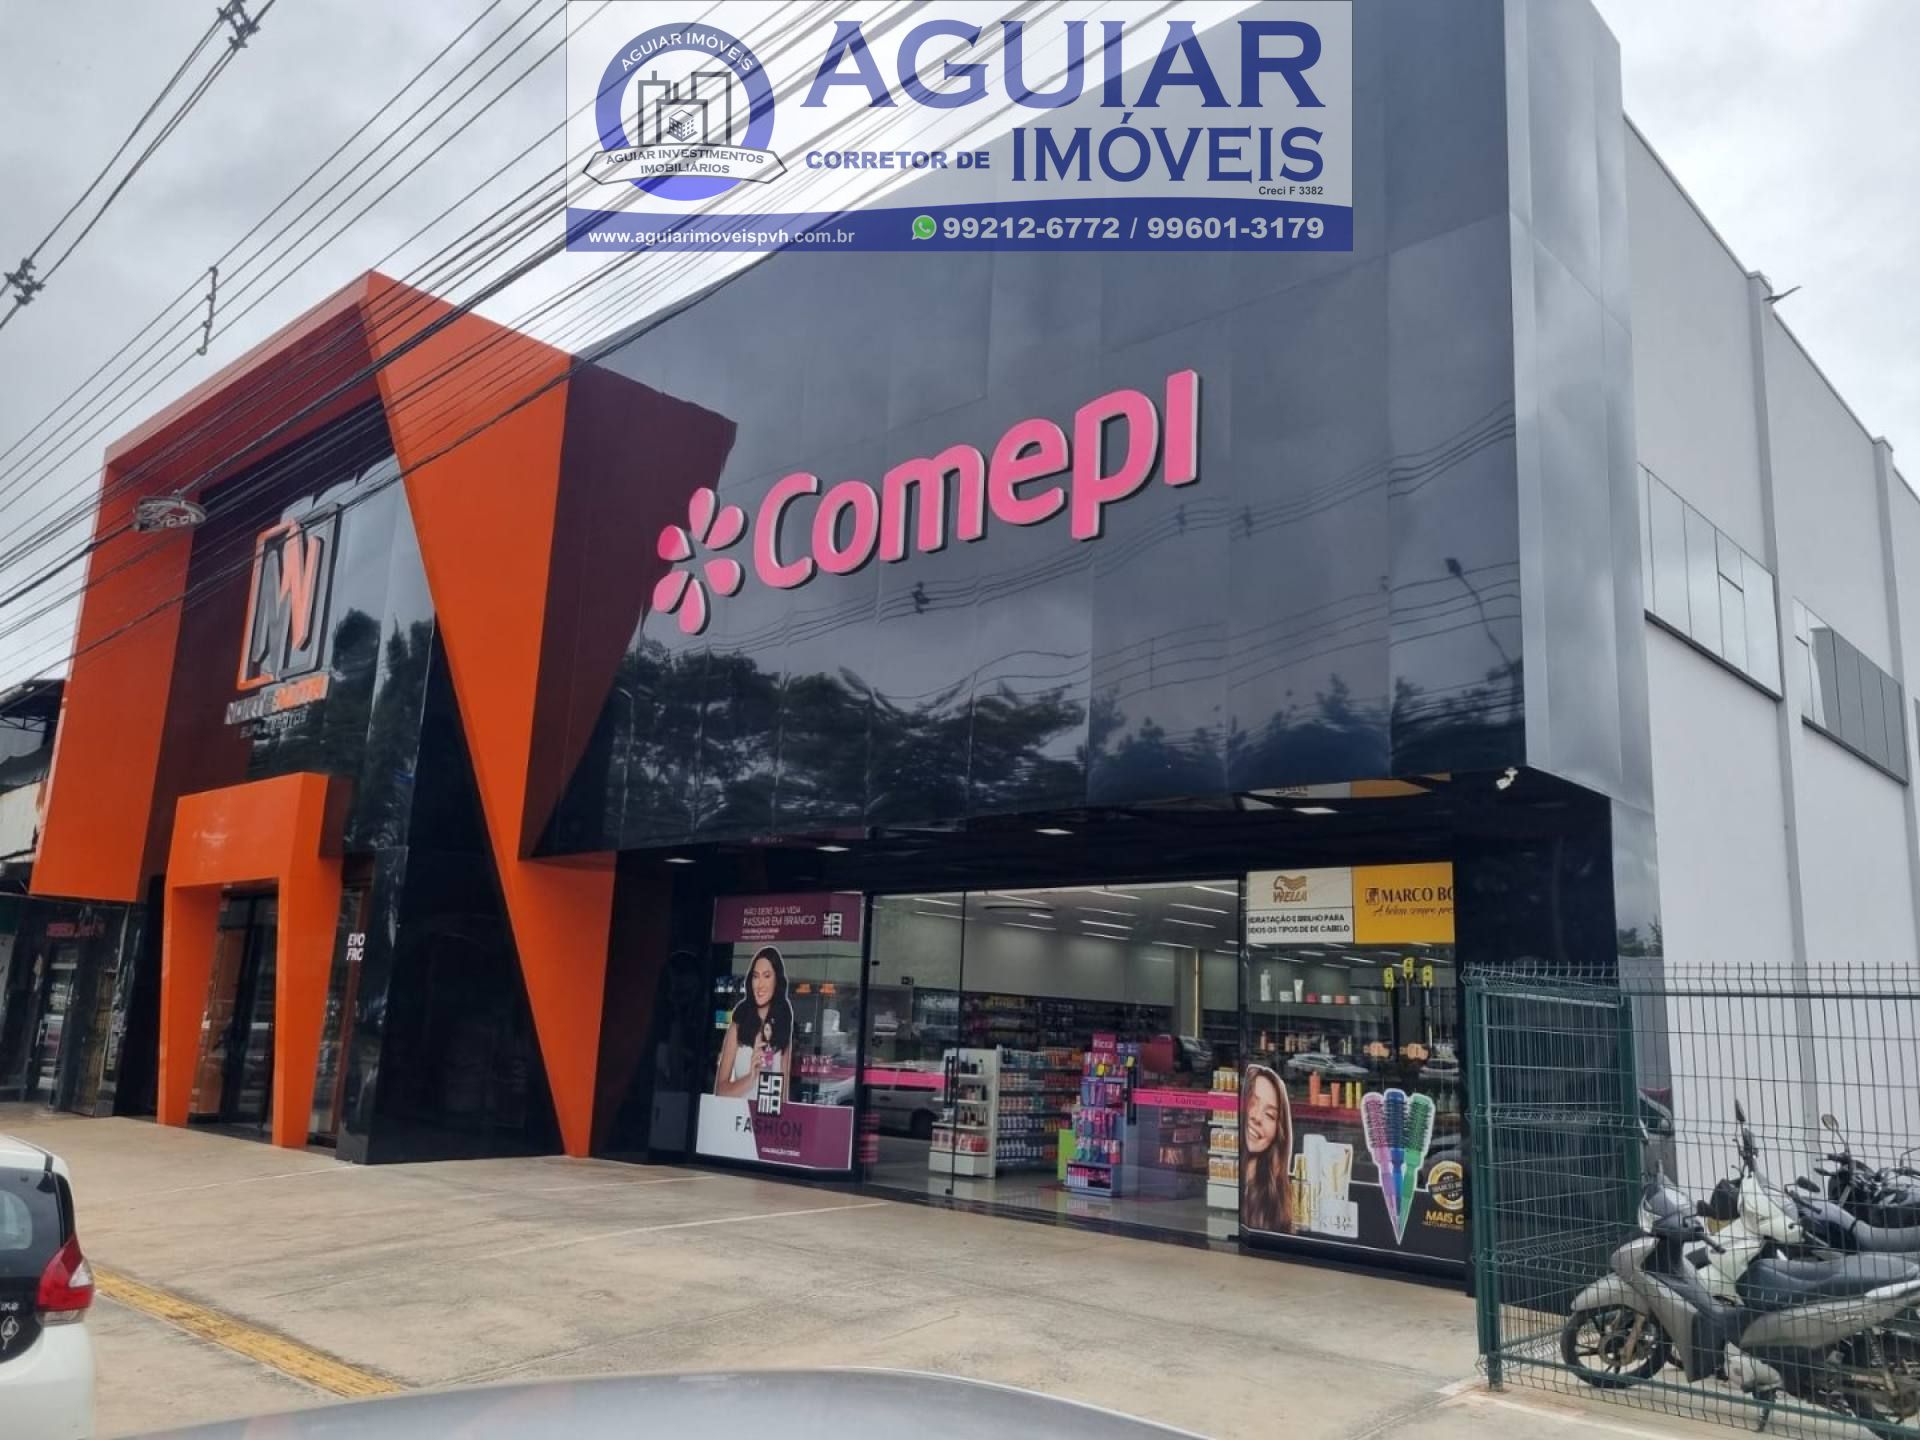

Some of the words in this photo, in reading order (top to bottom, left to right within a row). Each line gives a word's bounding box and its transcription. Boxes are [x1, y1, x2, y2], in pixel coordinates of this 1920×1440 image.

[1273, 890, 1308, 903] WELLA
[1381, 887, 1433, 903] MARCO
[1324, 913, 1345, 922] PARA
[1279, 925, 1299, 933] TIPOS
[1320, 924, 1350, 933] CABELO
[735, 1115, 802, 1137] FASHION
[1425, 1210, 1453, 1225] MAIS
